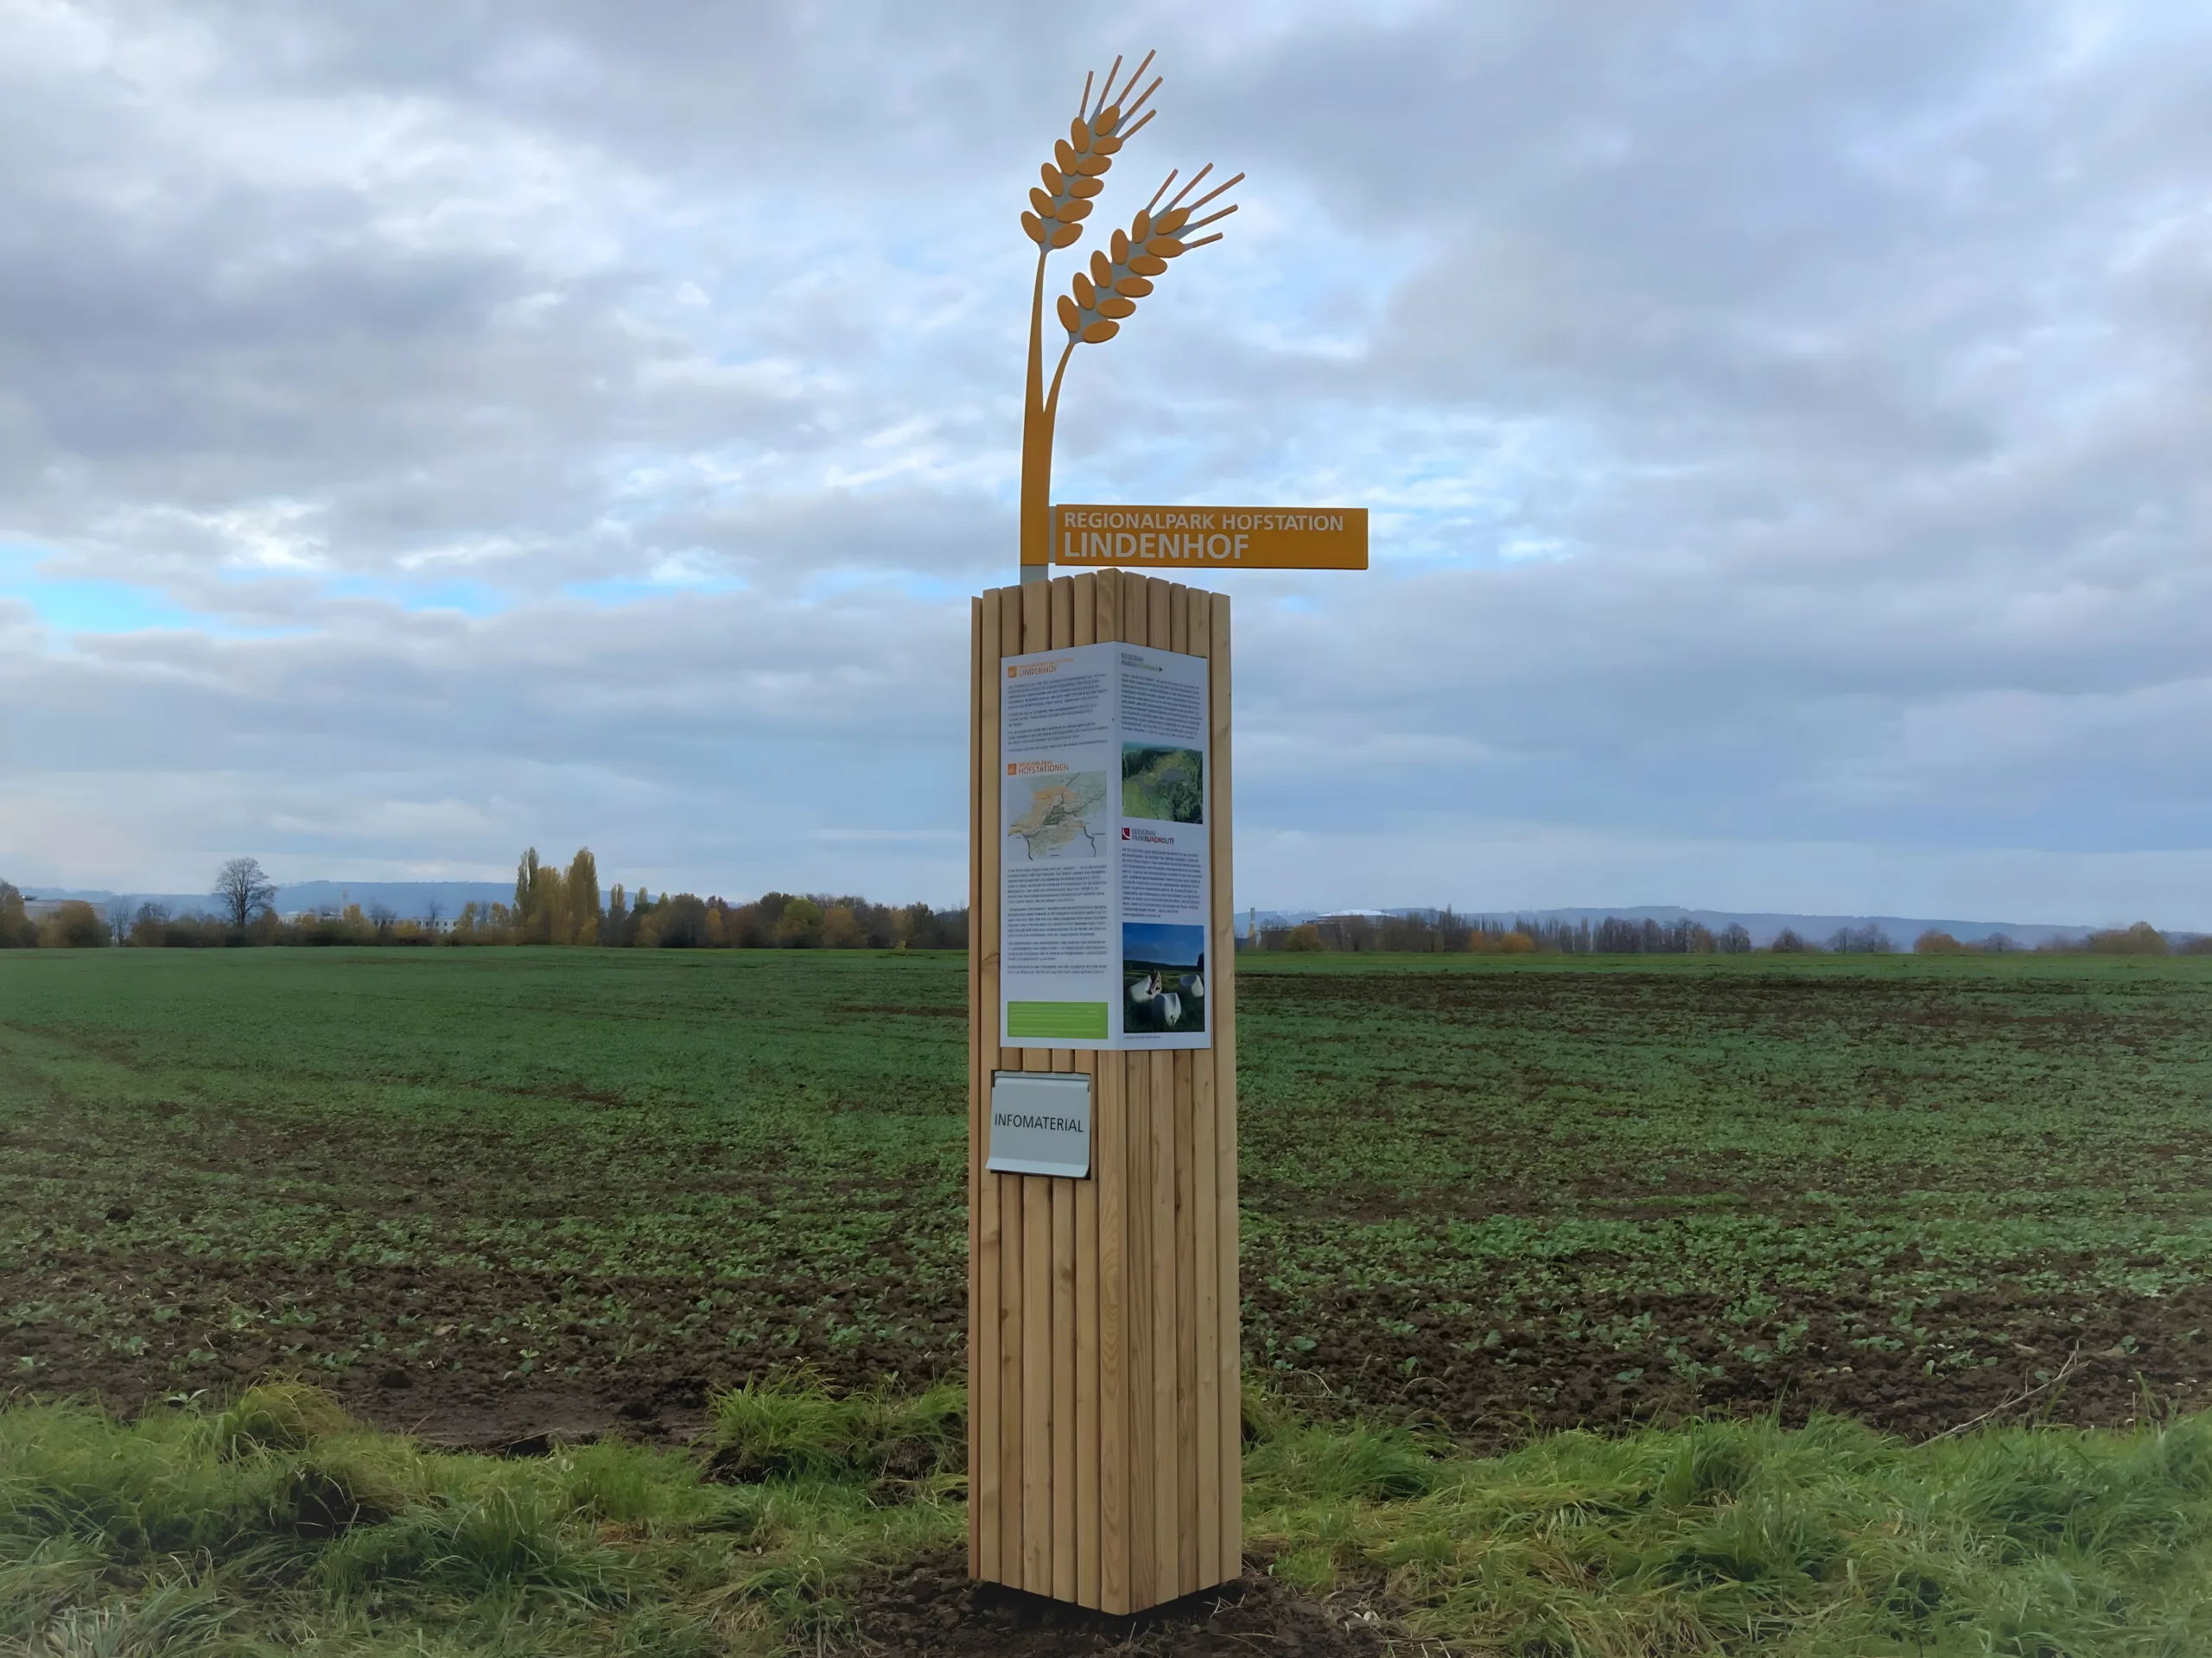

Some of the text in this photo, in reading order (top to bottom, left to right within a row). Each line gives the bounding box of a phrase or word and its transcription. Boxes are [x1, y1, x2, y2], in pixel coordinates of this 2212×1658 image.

[1064, 511, 1344, 531] REGIONALPARK HOFSTATION
[1064, 532, 1249, 559] LINDENHOF
[1019, 764, 1069, 775] HOFSTATIONEN
[995, 1113, 1084, 1133] INFOMATERIAL
